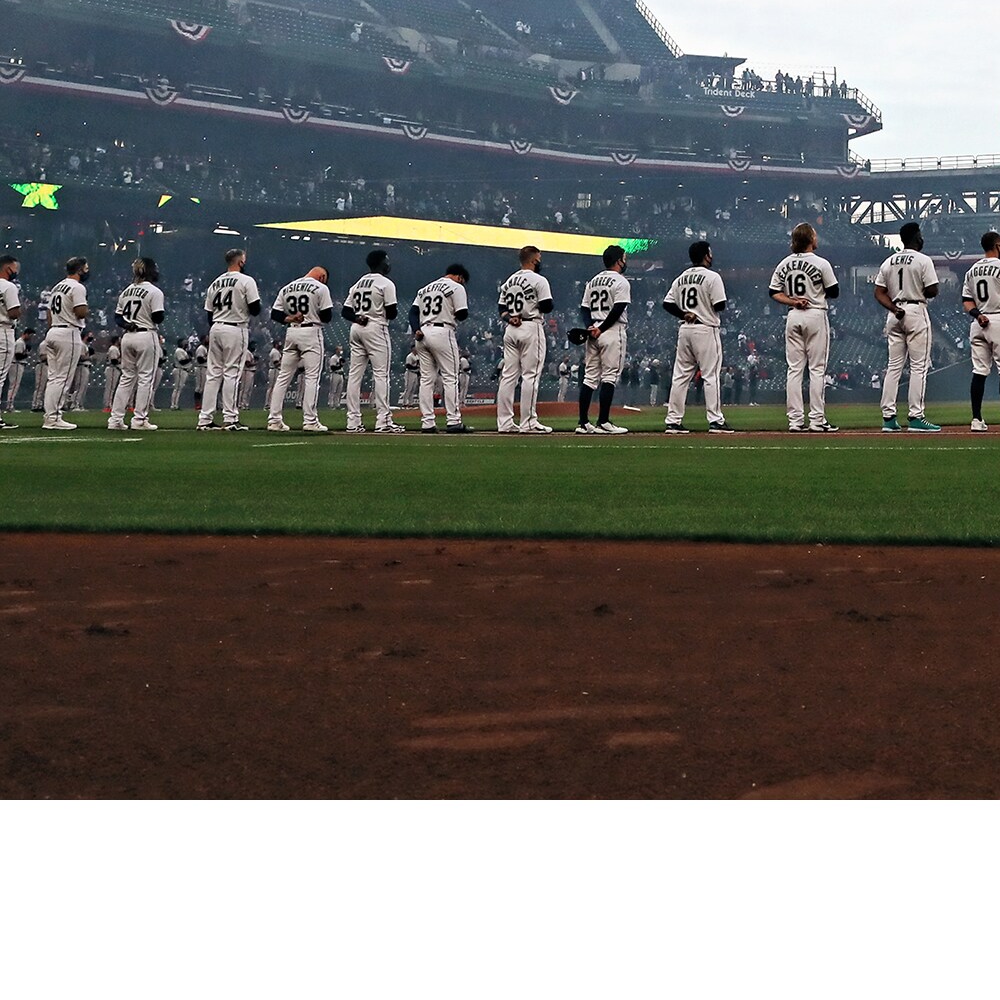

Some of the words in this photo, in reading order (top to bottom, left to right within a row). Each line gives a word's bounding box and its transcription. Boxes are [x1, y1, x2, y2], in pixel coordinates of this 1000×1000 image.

[703, 86, 732, 97] Trident
[735, 88, 756, 98] Deck
[890, 255, 915, 266] LEWIS
[786, 274, 806, 297] 16
[897, 267, 904, 291] 1
[212, 290, 233, 311] 44
[353, 291, 372, 312] 35
[590, 289, 610, 312] 22
[681, 287, 698, 310] 18
[976, 279, 989, 303] 0
[51, 295, 62, 315] 49
[122, 300, 142, 321] 47
[286, 294, 310, 315] 38
[422, 295, 443, 316] 33
[505, 291, 524, 314] 26
